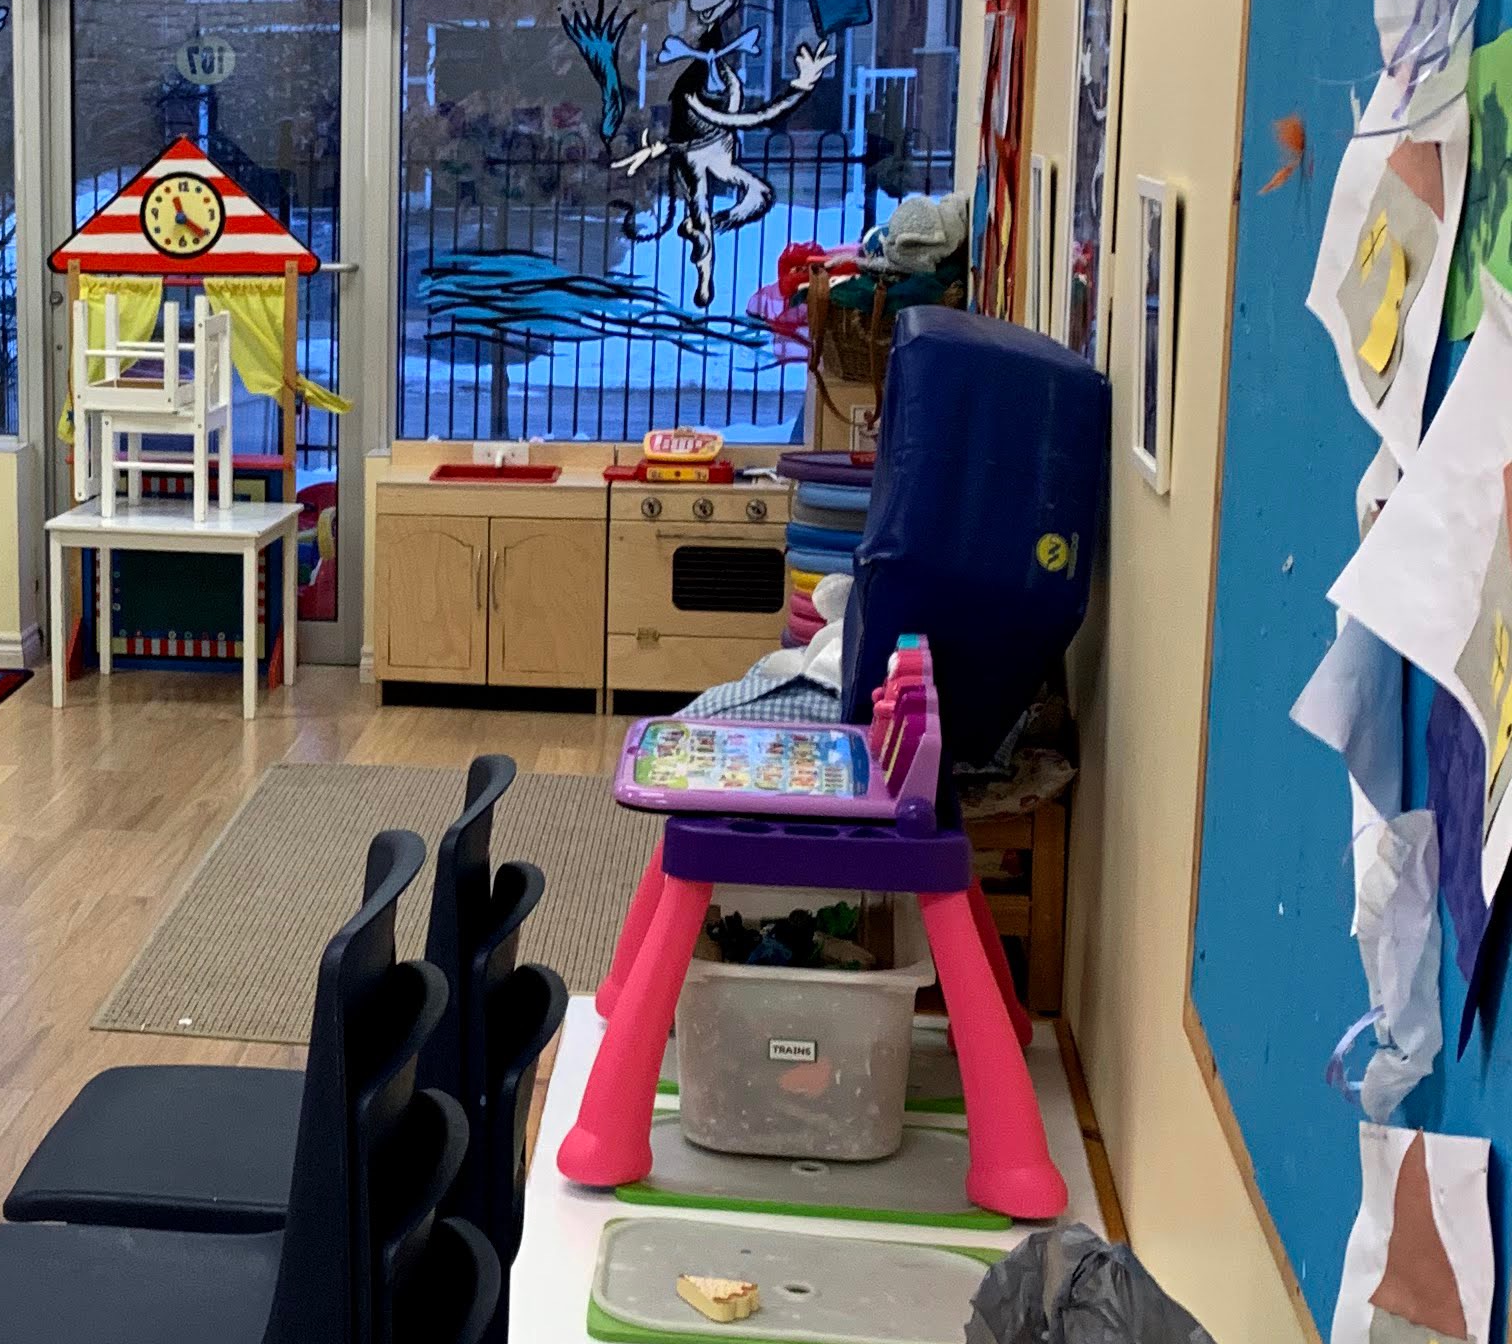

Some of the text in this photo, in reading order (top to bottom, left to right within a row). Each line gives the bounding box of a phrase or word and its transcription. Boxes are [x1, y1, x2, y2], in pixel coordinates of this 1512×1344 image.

[178, 181, 190, 192] 12
[151, 208, 159, 221] 9
[208, 208, 215, 222] 3
[178, 235, 187, 248] 6
[773, 1044, 812, 1057] TRAINS
